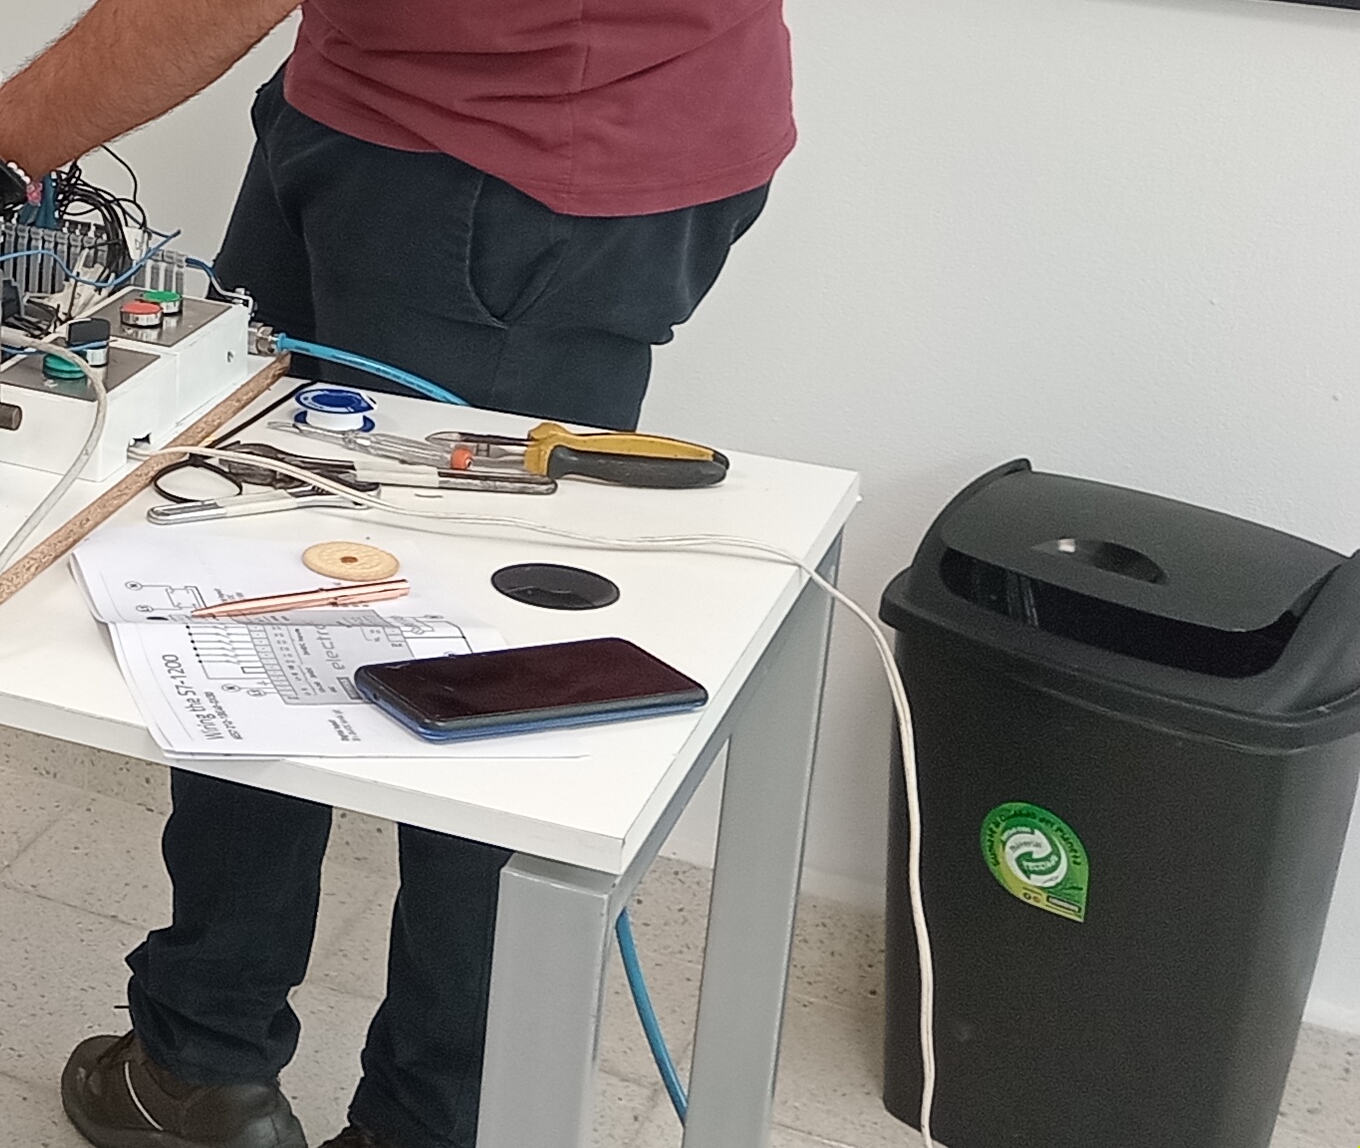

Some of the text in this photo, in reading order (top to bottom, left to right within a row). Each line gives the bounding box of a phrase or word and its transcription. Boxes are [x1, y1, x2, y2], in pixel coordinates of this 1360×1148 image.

[161, 653, 224, 740] Wiring the S7-1200
